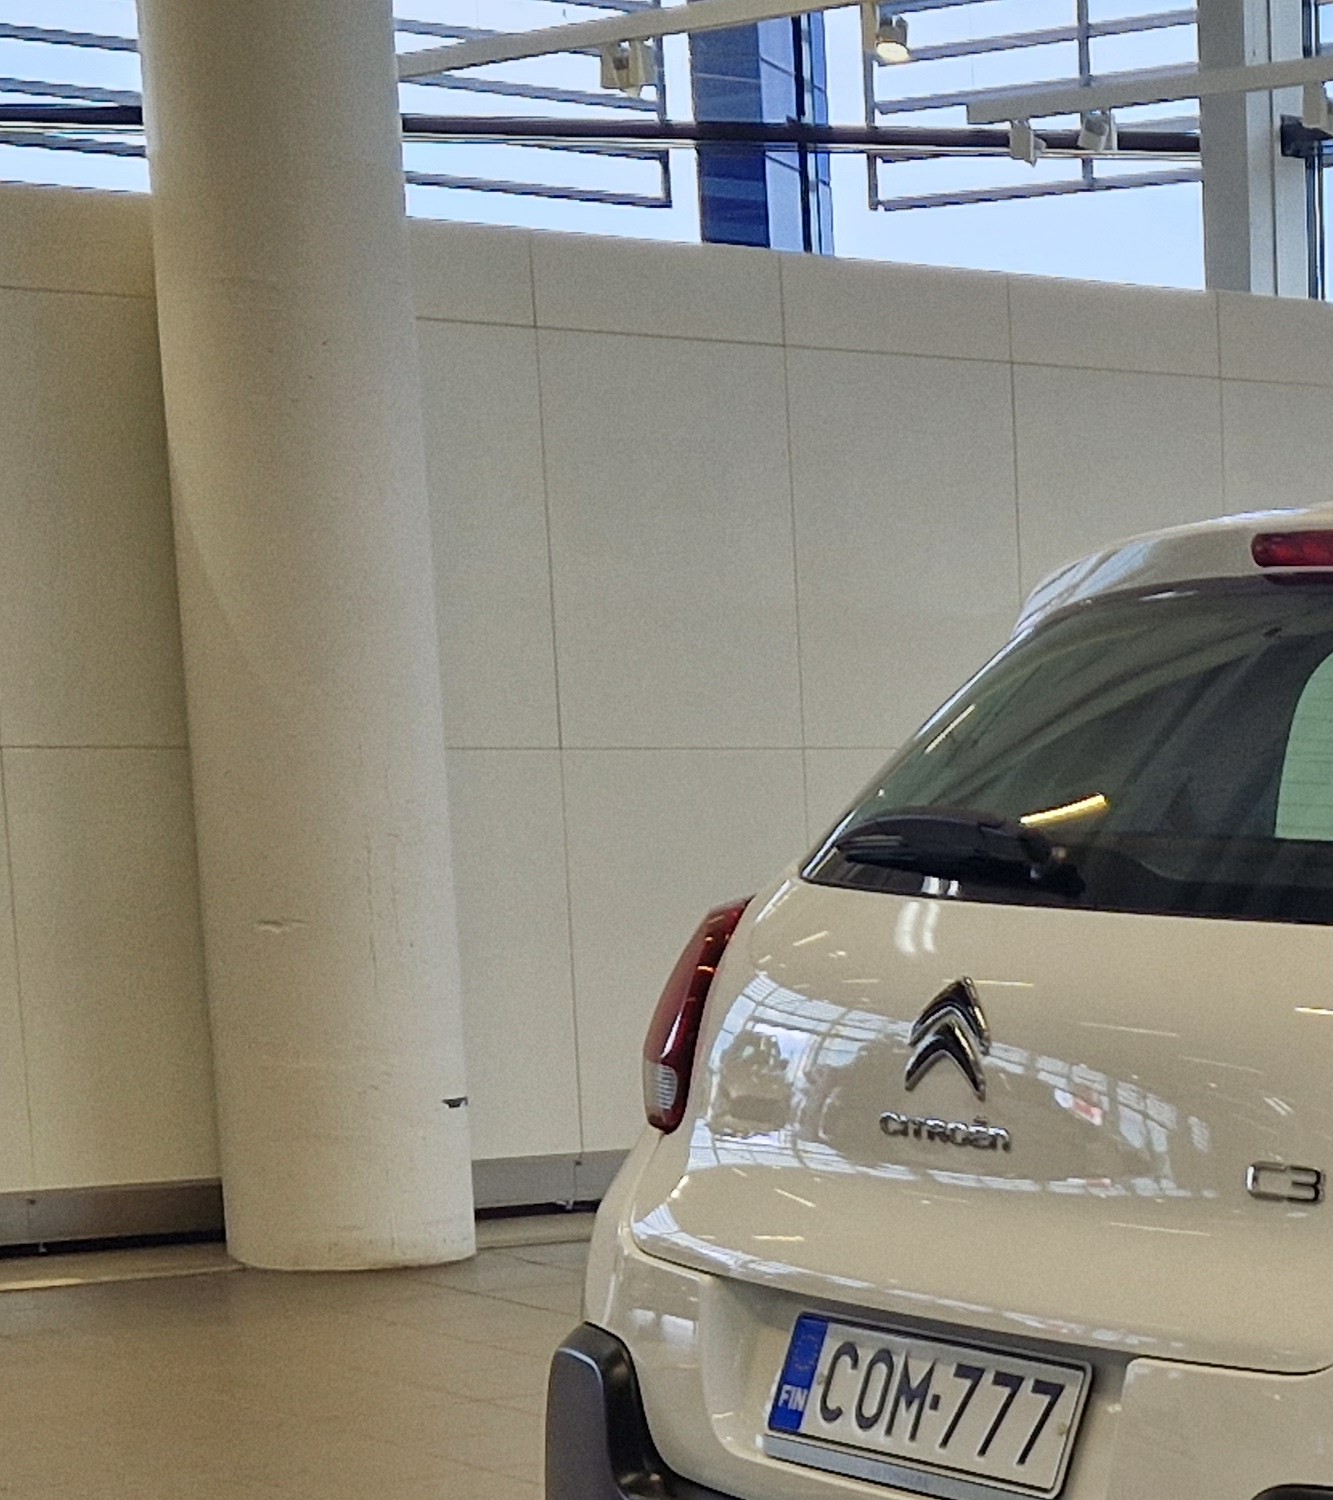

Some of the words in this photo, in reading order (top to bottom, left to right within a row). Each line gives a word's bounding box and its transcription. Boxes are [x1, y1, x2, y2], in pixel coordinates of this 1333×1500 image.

[1245, 1160, 1326, 1206] C3
[777, 1384, 808, 1412] FIN
[819, 1340, 1066, 1466] COM-777
